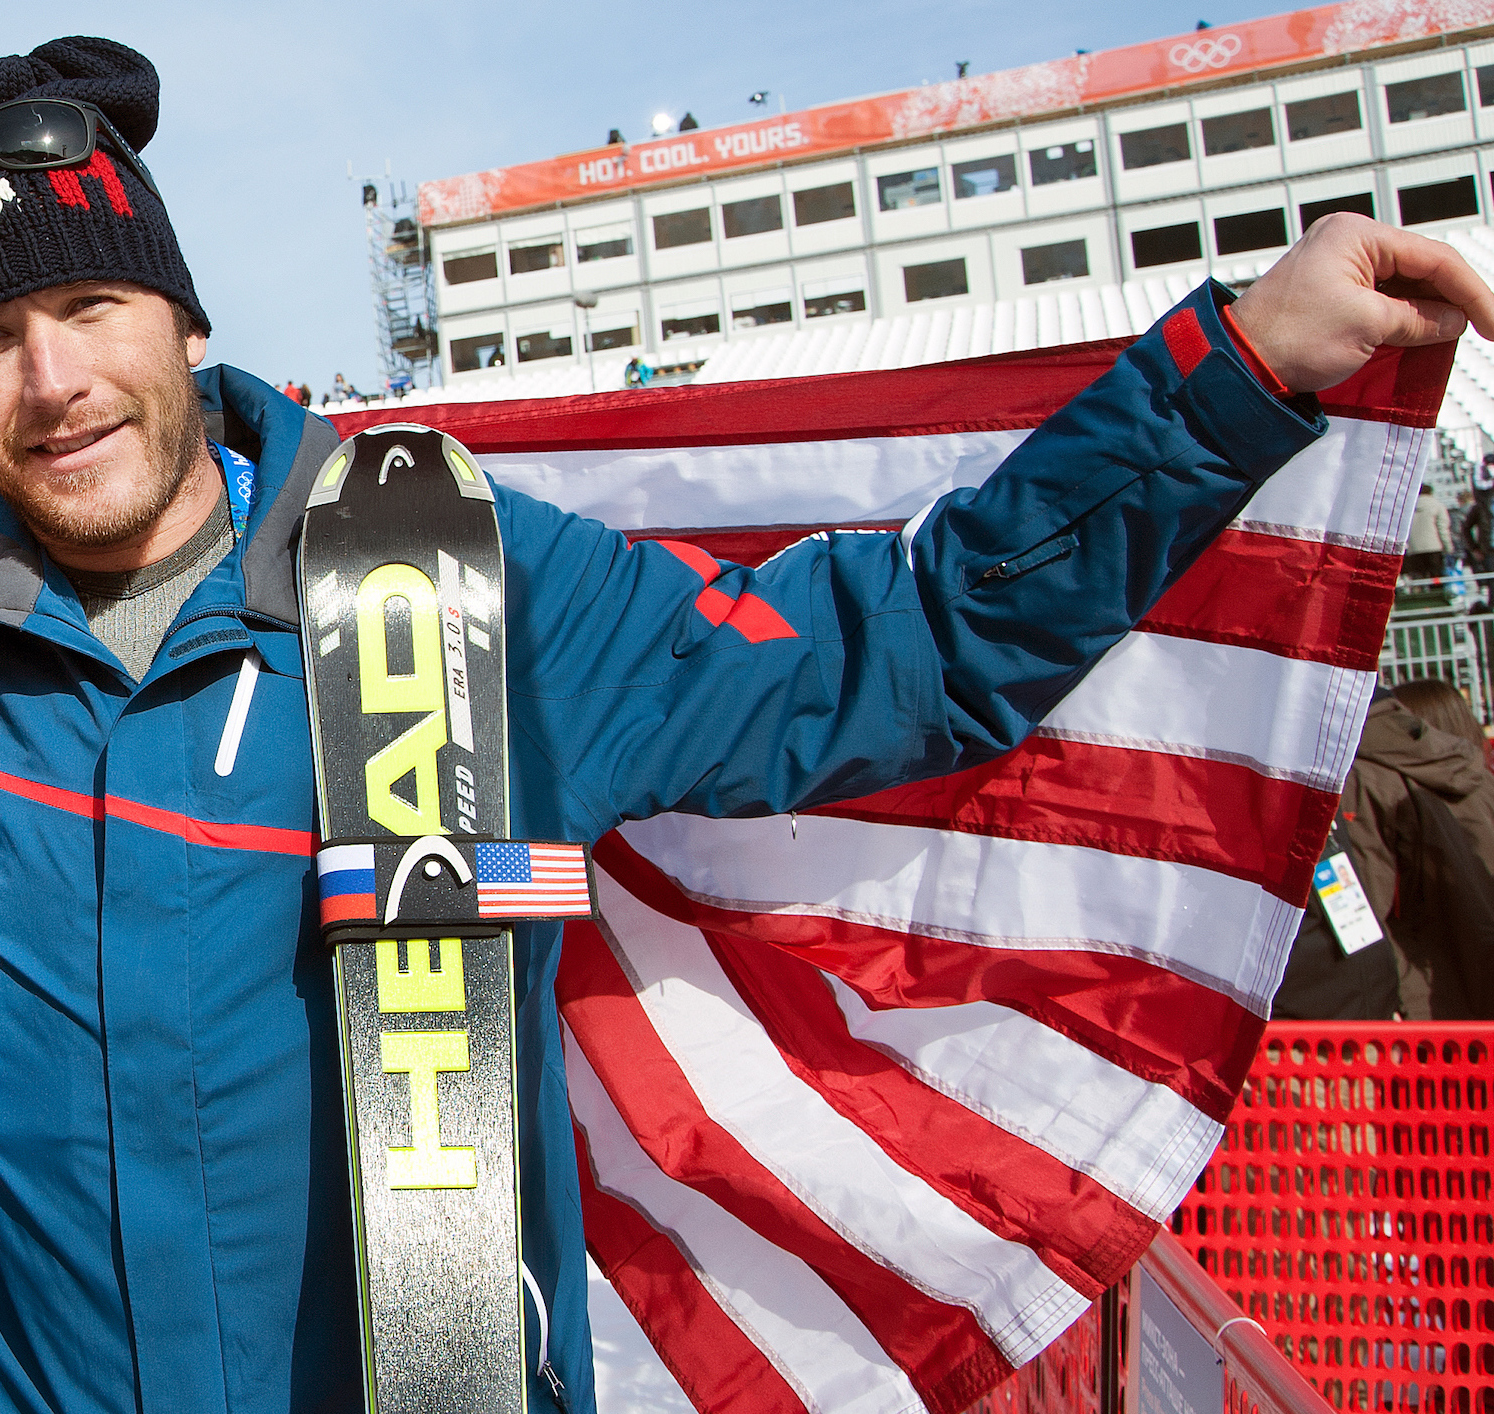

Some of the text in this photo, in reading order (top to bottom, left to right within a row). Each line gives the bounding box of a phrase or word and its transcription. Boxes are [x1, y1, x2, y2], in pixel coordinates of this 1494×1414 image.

[578, 122, 810, 186] HOT. COOL. YOURS.
[446, 621, 462, 655] 3.0
[454, 669, 466, 700] ERA
[455, 764, 478, 835] PEED
[356, 562, 478, 1191] HEAD
